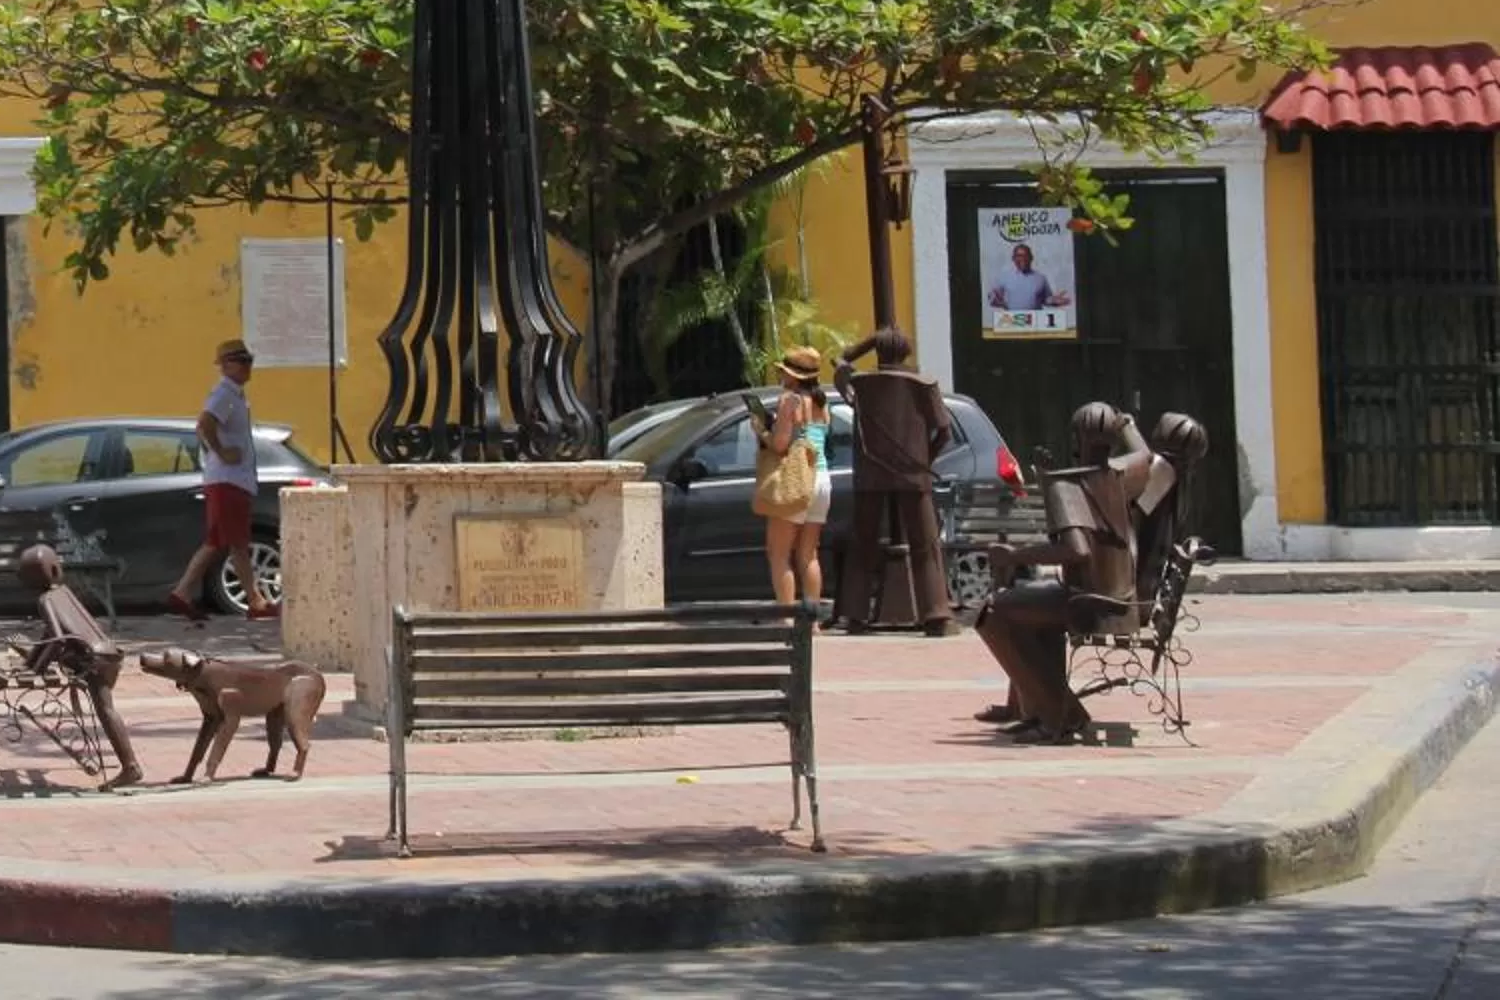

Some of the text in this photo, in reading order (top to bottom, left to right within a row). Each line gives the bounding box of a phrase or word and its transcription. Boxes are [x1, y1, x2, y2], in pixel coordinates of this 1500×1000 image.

[992, 211, 1049, 227] AMERICO
[1008, 223, 1061, 236] MENDOZA
[1046, 313, 1056, 327] 1
